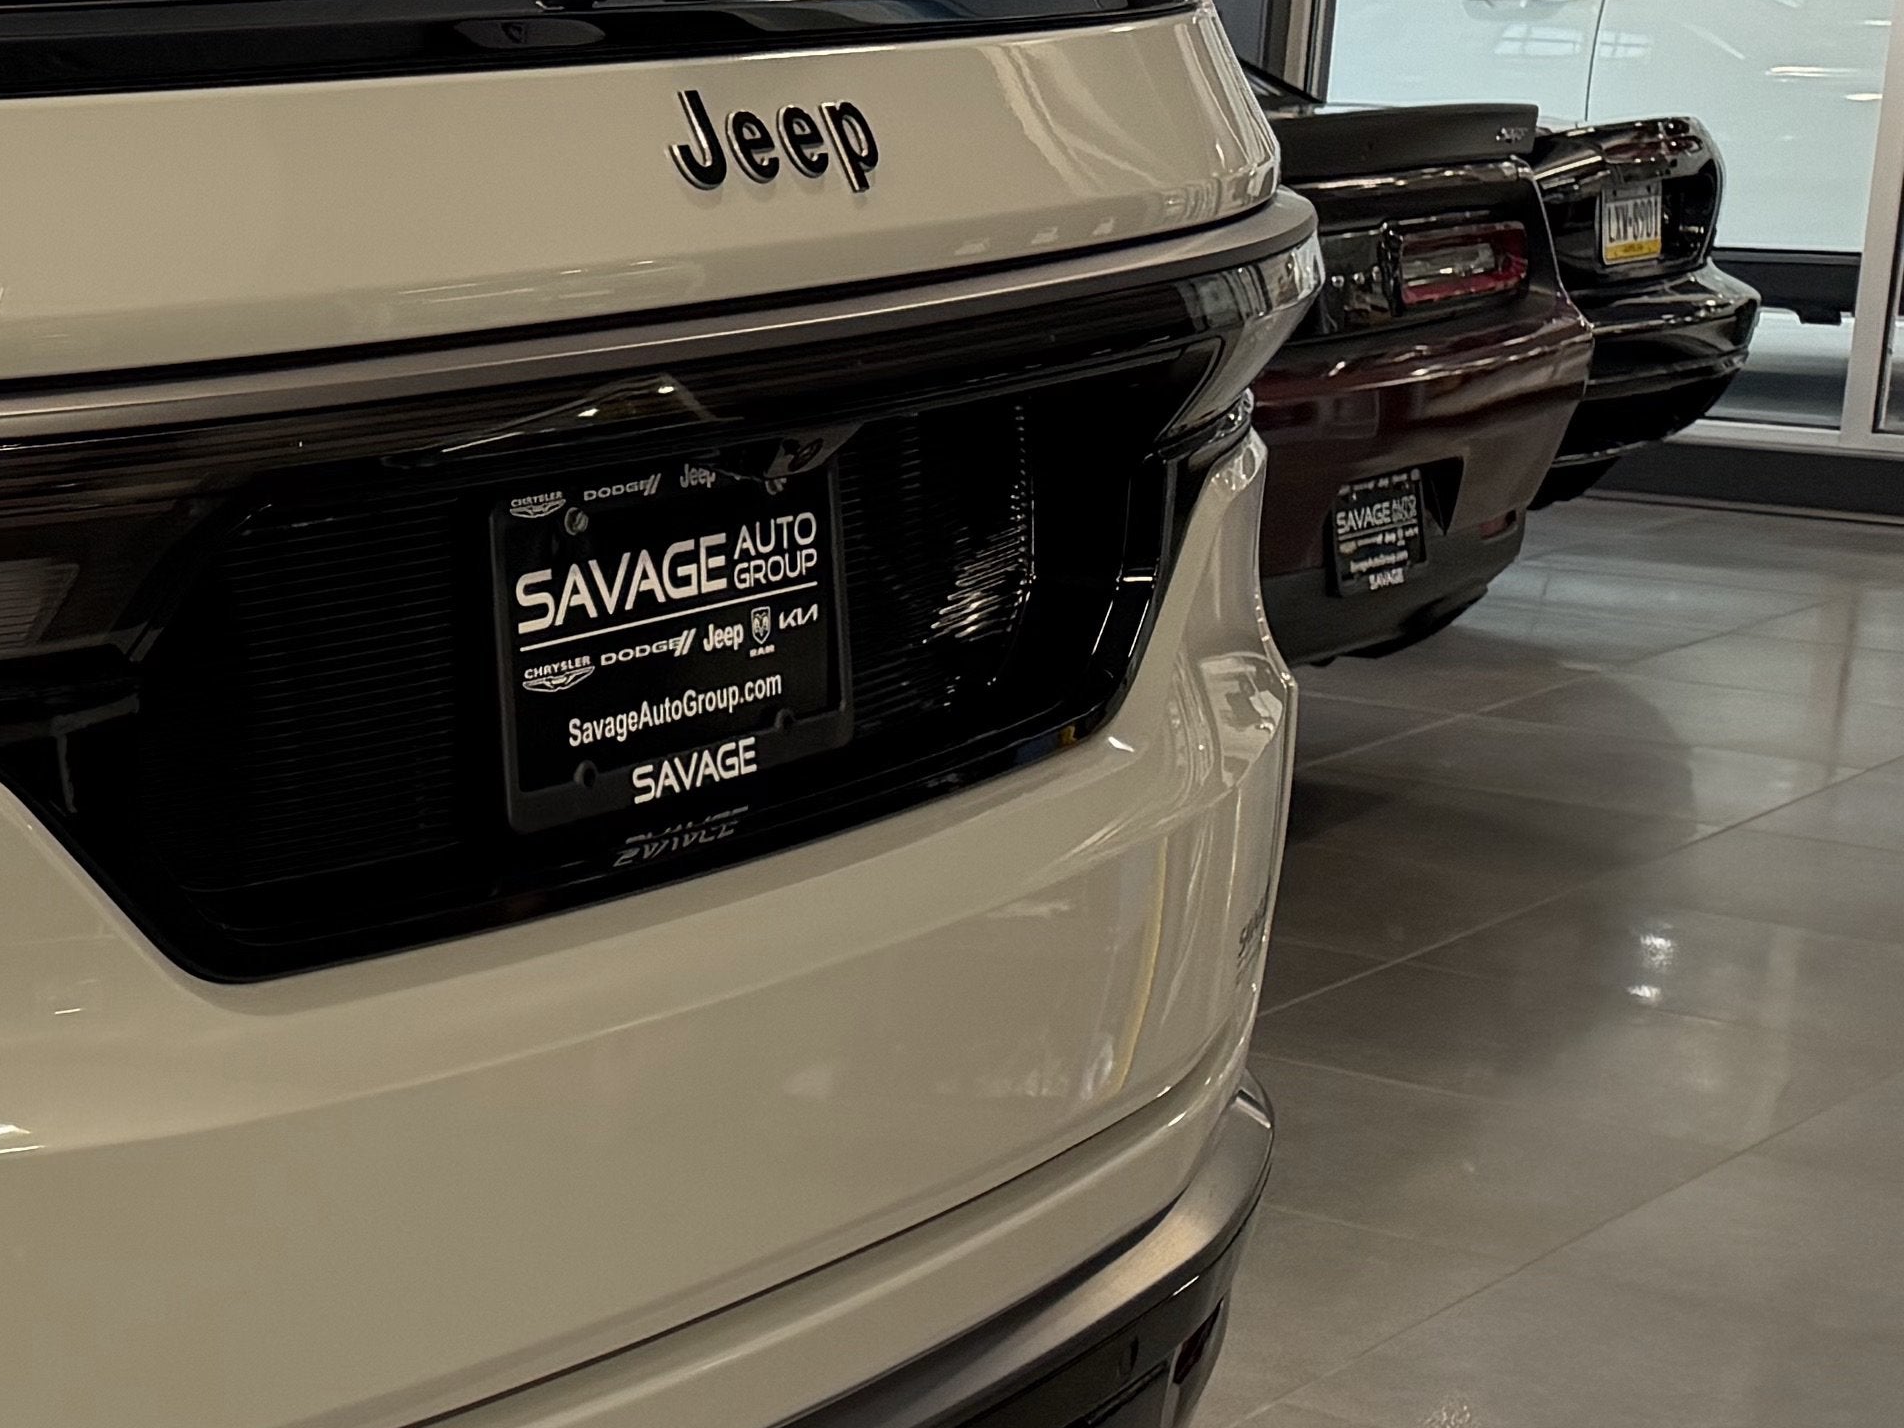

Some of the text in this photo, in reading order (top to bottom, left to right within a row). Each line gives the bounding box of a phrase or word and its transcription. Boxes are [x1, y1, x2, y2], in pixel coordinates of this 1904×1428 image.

[669, 89, 879, 193] Jeep
[679, 463, 716, 489] Jeep
[733, 511, 818, 561] AUTO
[1337, 501, 1391, 534] SAVAGE
[515, 532, 727, 635] SAVAGE
[733, 547, 818, 590] GROUP
[600, 634, 683, 667] DODGE
[703, 620, 745, 653] Jeep
[749, 644, 775, 658] RAM
[524, 655, 592, 680] CHRYSLER
[568, 672, 783, 748] SavageAutoGroup.com
[631, 736, 758, 804] SAVAGE
